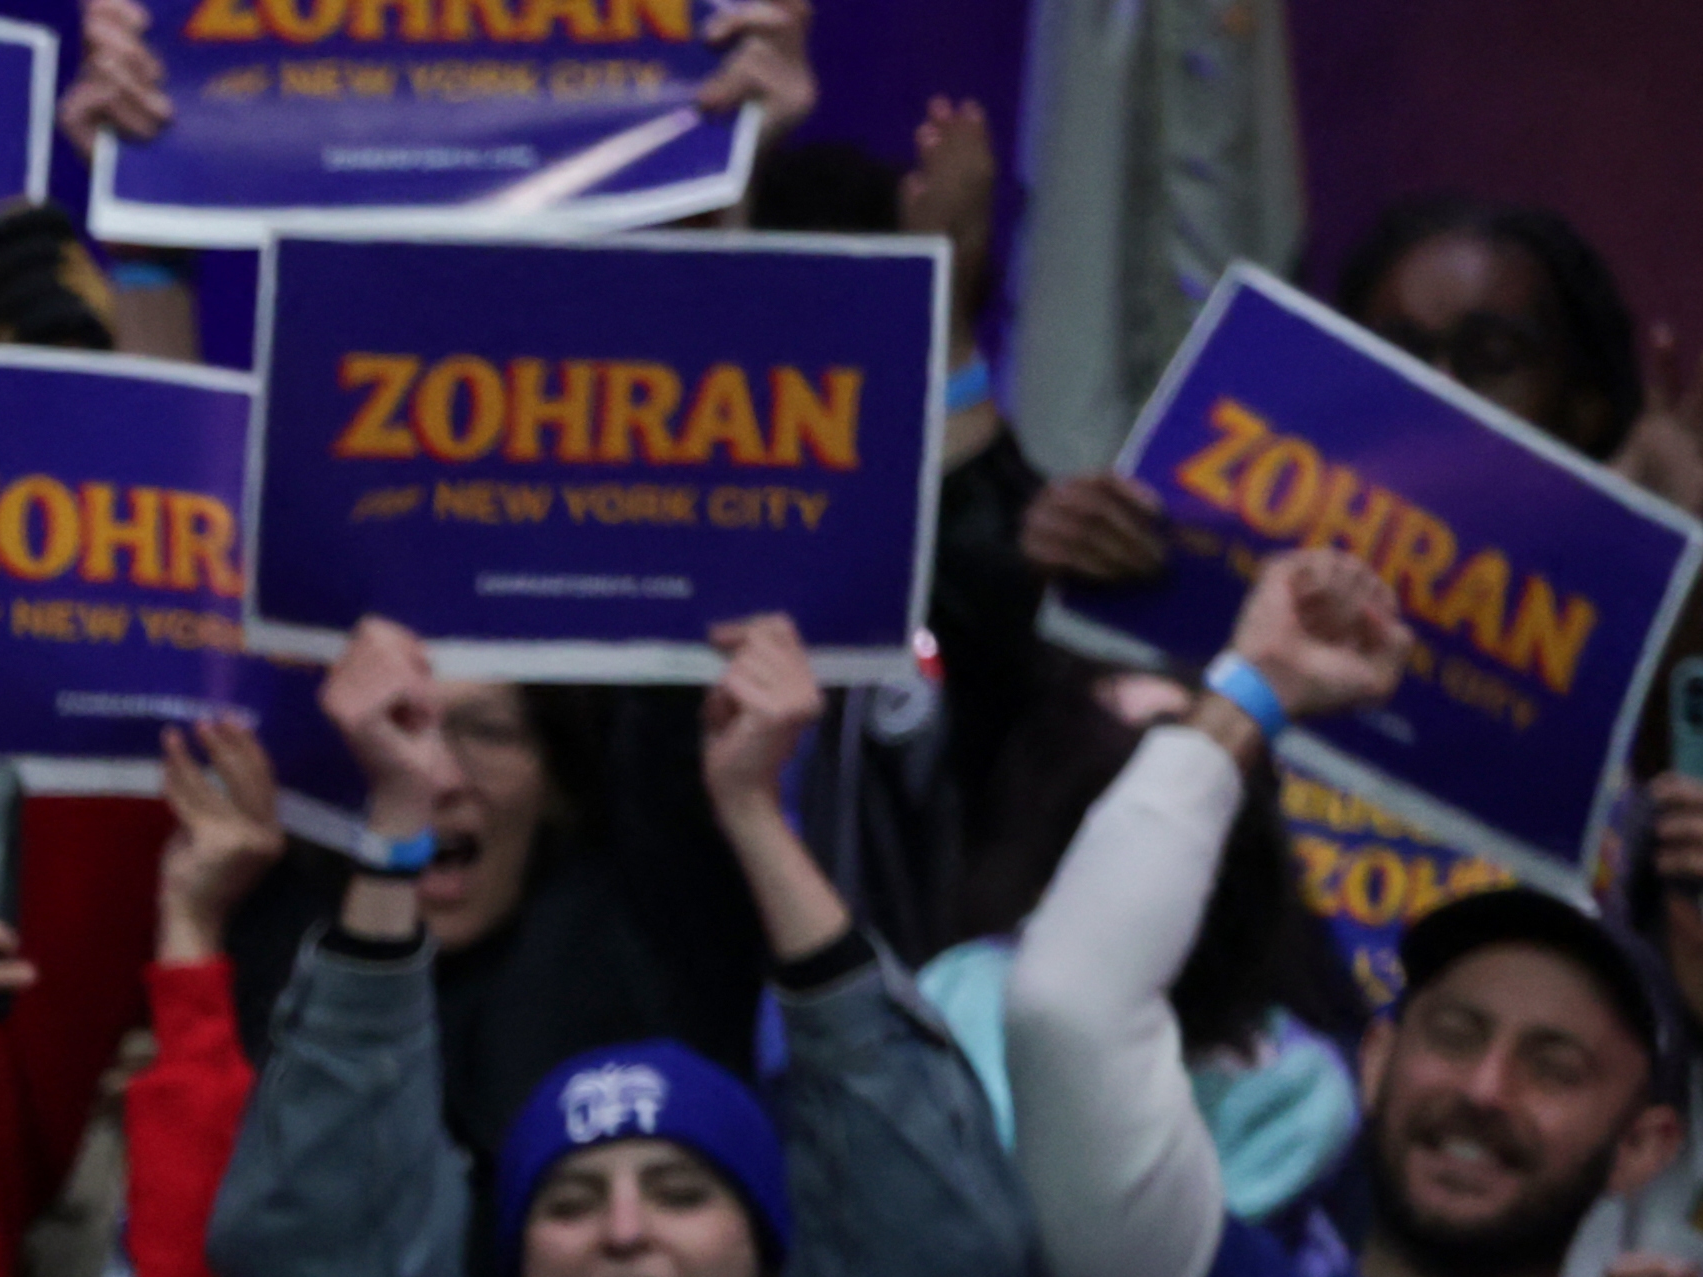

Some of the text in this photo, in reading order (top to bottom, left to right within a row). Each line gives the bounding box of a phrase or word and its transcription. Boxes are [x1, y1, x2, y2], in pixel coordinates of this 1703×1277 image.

[329, 351, 866, 473] ZOHRAN
[431, 476, 557, 527] NEW
[561, 480, 699, 529] YORK
[705, 483, 831, 534] CITY
[1173, 393, 1600, 697] ZOHRAN
[8, 595, 133, 647] NEW
